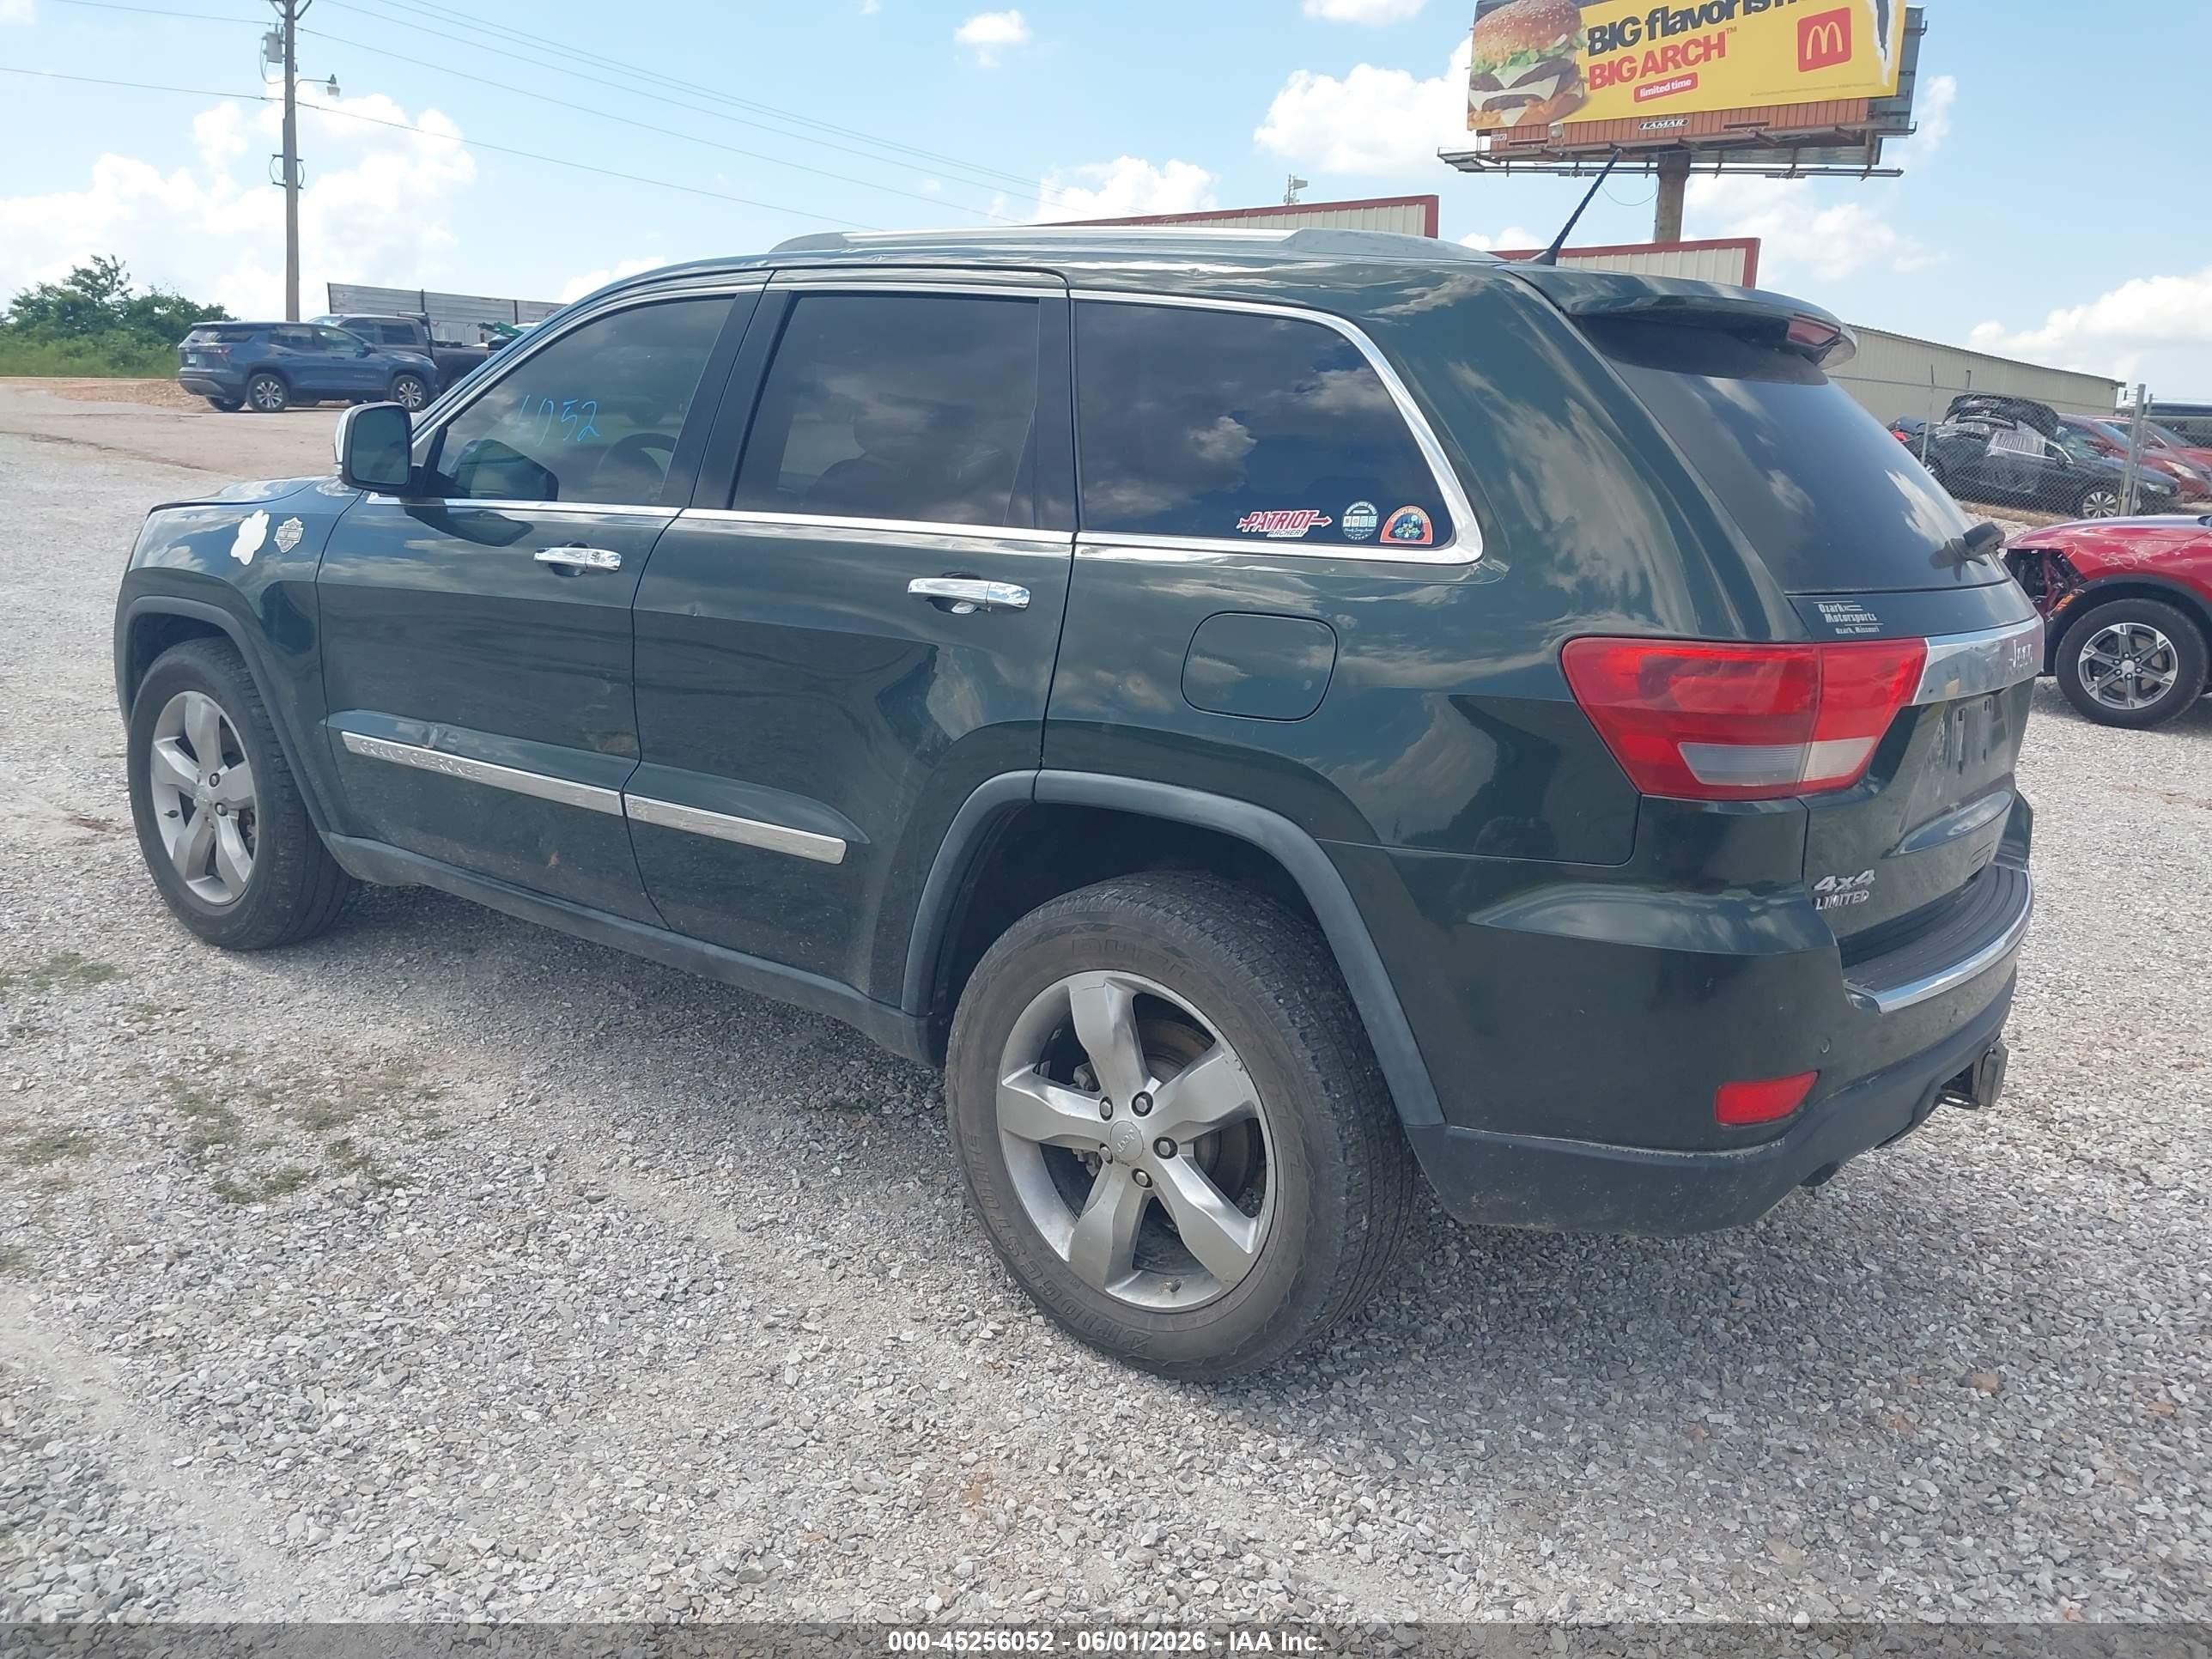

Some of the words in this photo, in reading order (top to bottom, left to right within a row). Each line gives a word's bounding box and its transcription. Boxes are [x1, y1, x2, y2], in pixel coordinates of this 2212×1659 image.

[1588, 16, 1643, 58] BIG
[1645, 0, 1740, 40] flavor
[1589, 55, 1638, 91] BIG
[1639, 79, 1671, 99] limited
[1670, 77, 1692, 92] time
[1642, 118, 1685, 131] LAMAR
[1243, 511, 1319, 532] PATRIOT
[1818, 604, 1845, 613] Ozark
[1824, 612, 1878, 623] Motorsports
[357, 738, 406, 763] GRAND
[410, 750, 483, 781] CHEROKEE
[1812, 868, 1876, 893] 4x4
[1814, 889, 1870, 911] LIMITED
